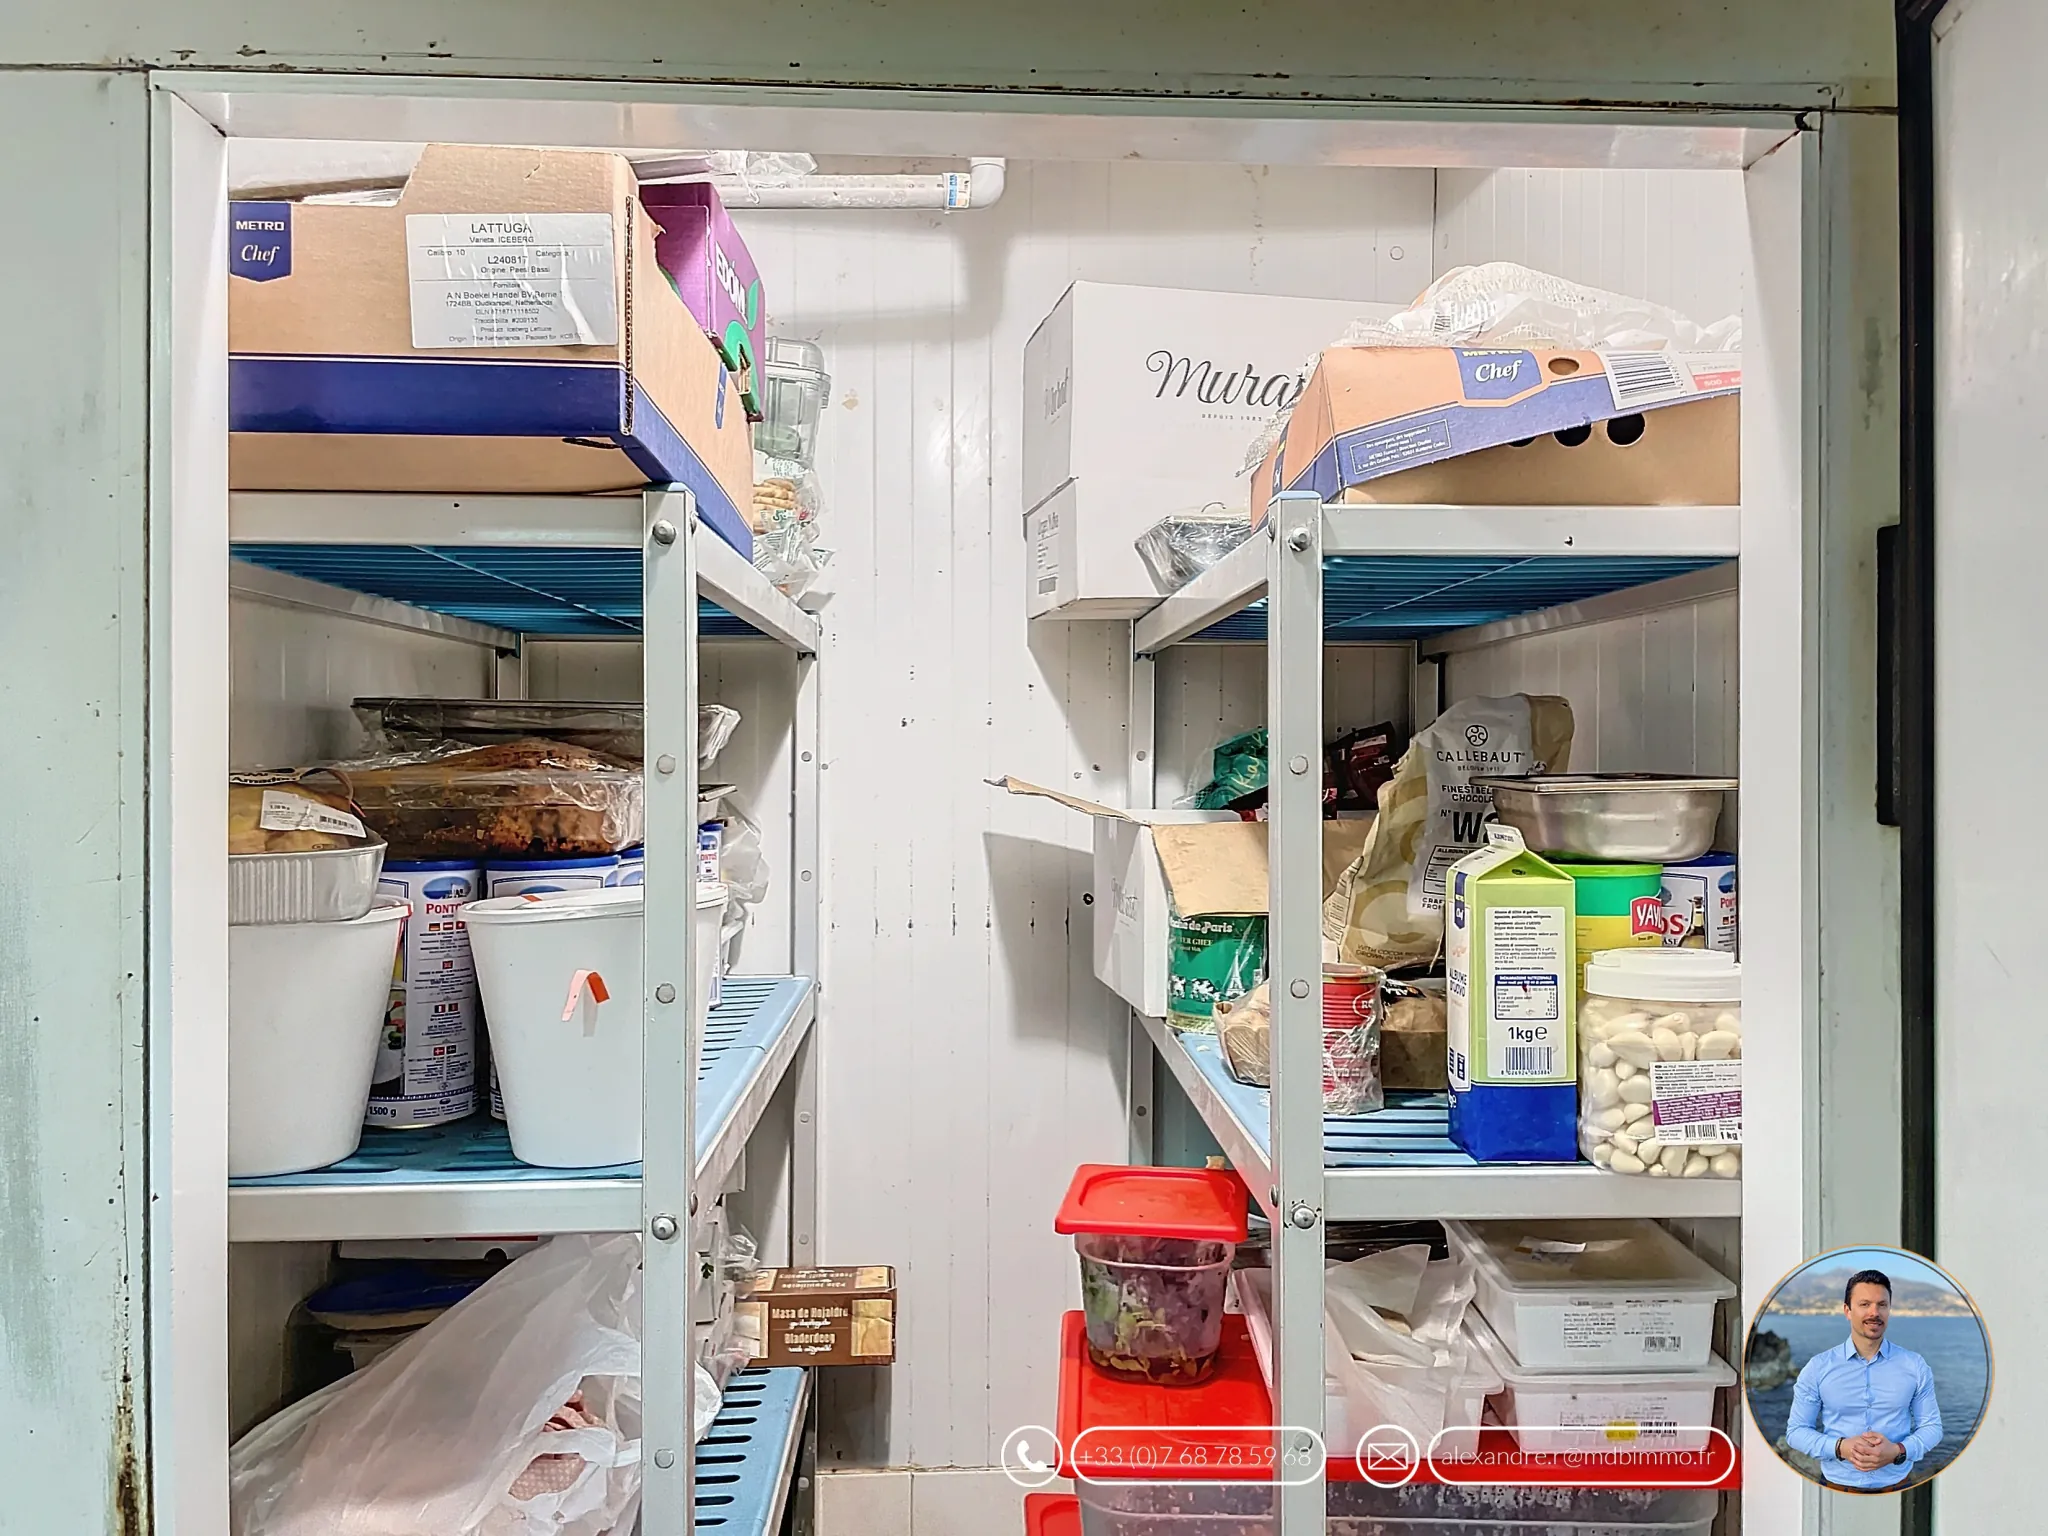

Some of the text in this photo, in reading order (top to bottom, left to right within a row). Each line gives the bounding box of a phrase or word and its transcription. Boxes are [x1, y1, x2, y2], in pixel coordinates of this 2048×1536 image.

[236, 220, 285, 231] METRO
[471, 223, 532, 234] LATTUGA
[241, 244, 280, 267] Chef
[492, 291, 520, 300] Handel
[1475, 359, 1523, 382] Chef
[1436, 751, 1522, 763] CALLEBAUT
[1441, 784, 1475, 795] FINEST
[1189, 921, 1201, 931] de
[1201, 921, 1233, 934] Paris
[390, 1108, 397, 1118] g
[771, 1308, 796, 1319] Masa
[797, 1307, 809, 1319] de
